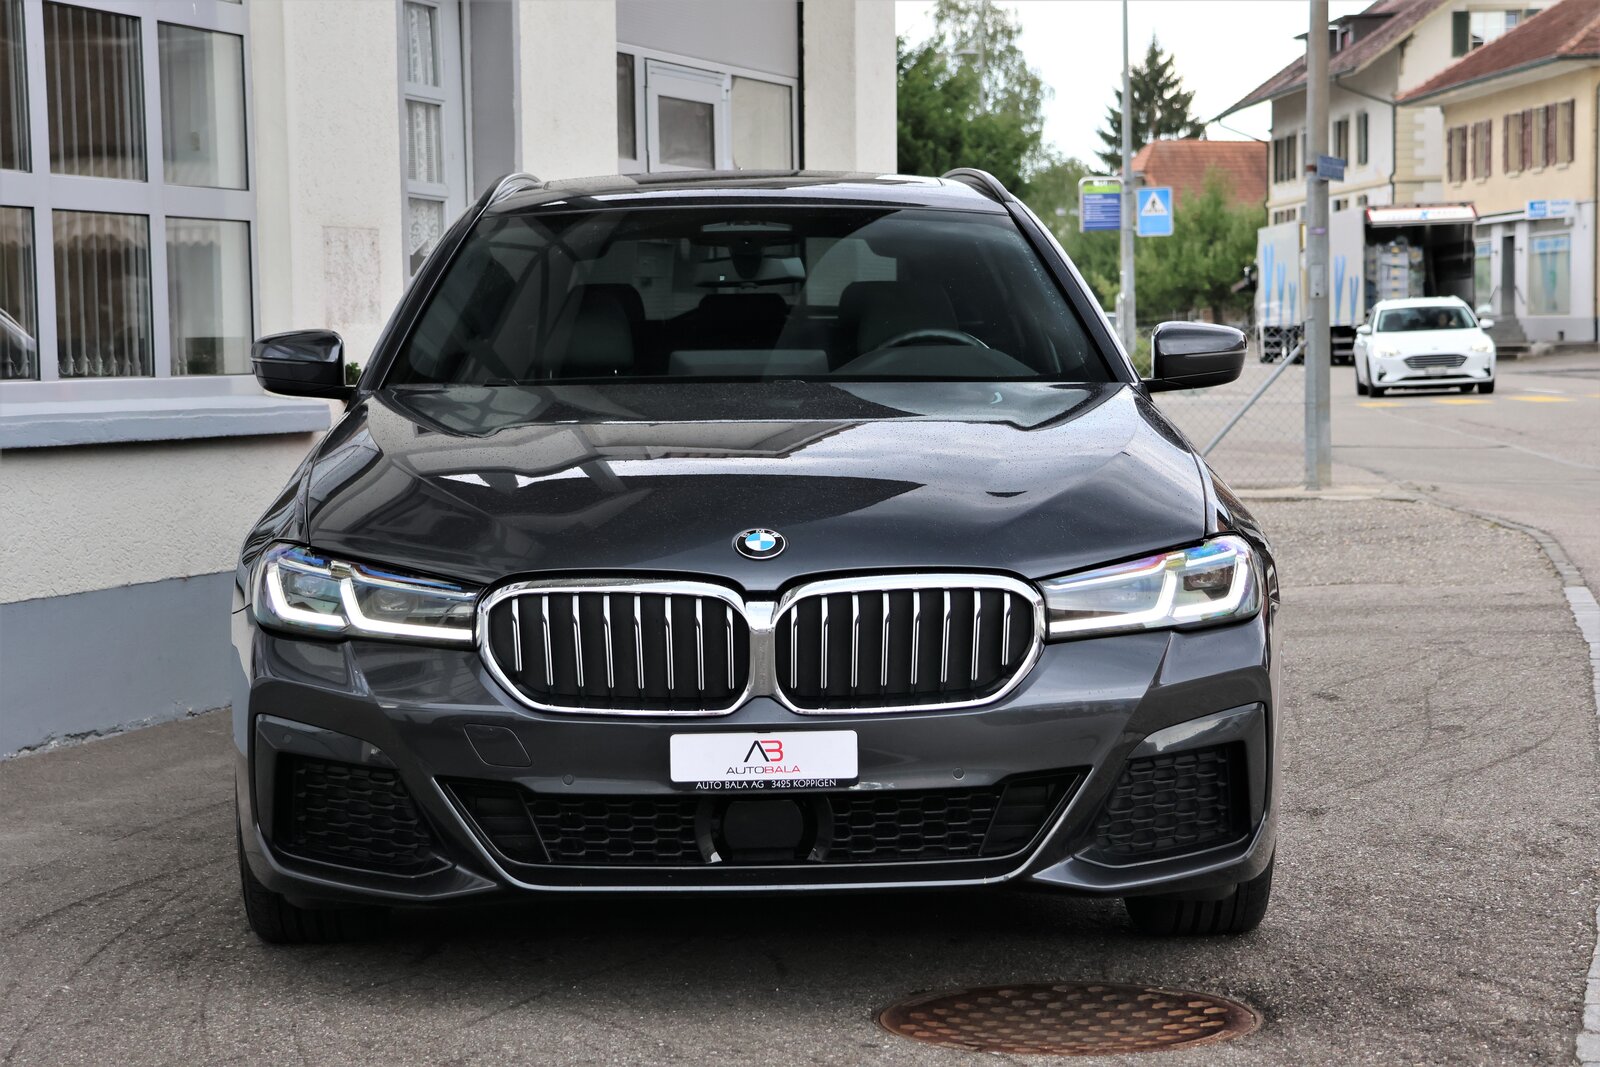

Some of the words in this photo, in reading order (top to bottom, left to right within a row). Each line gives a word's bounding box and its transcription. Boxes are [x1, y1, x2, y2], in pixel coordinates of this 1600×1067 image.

[743, 740, 784, 763] AB
[726, 765, 801, 775] AUTOBALA
[695, 781, 721, 790] AUTO
[725, 780, 748, 789] BALA
[750, 780, 765, 789] AG
[771, 780, 791, 788] 3425
[793, 779, 837, 788] KOPPIGEN
